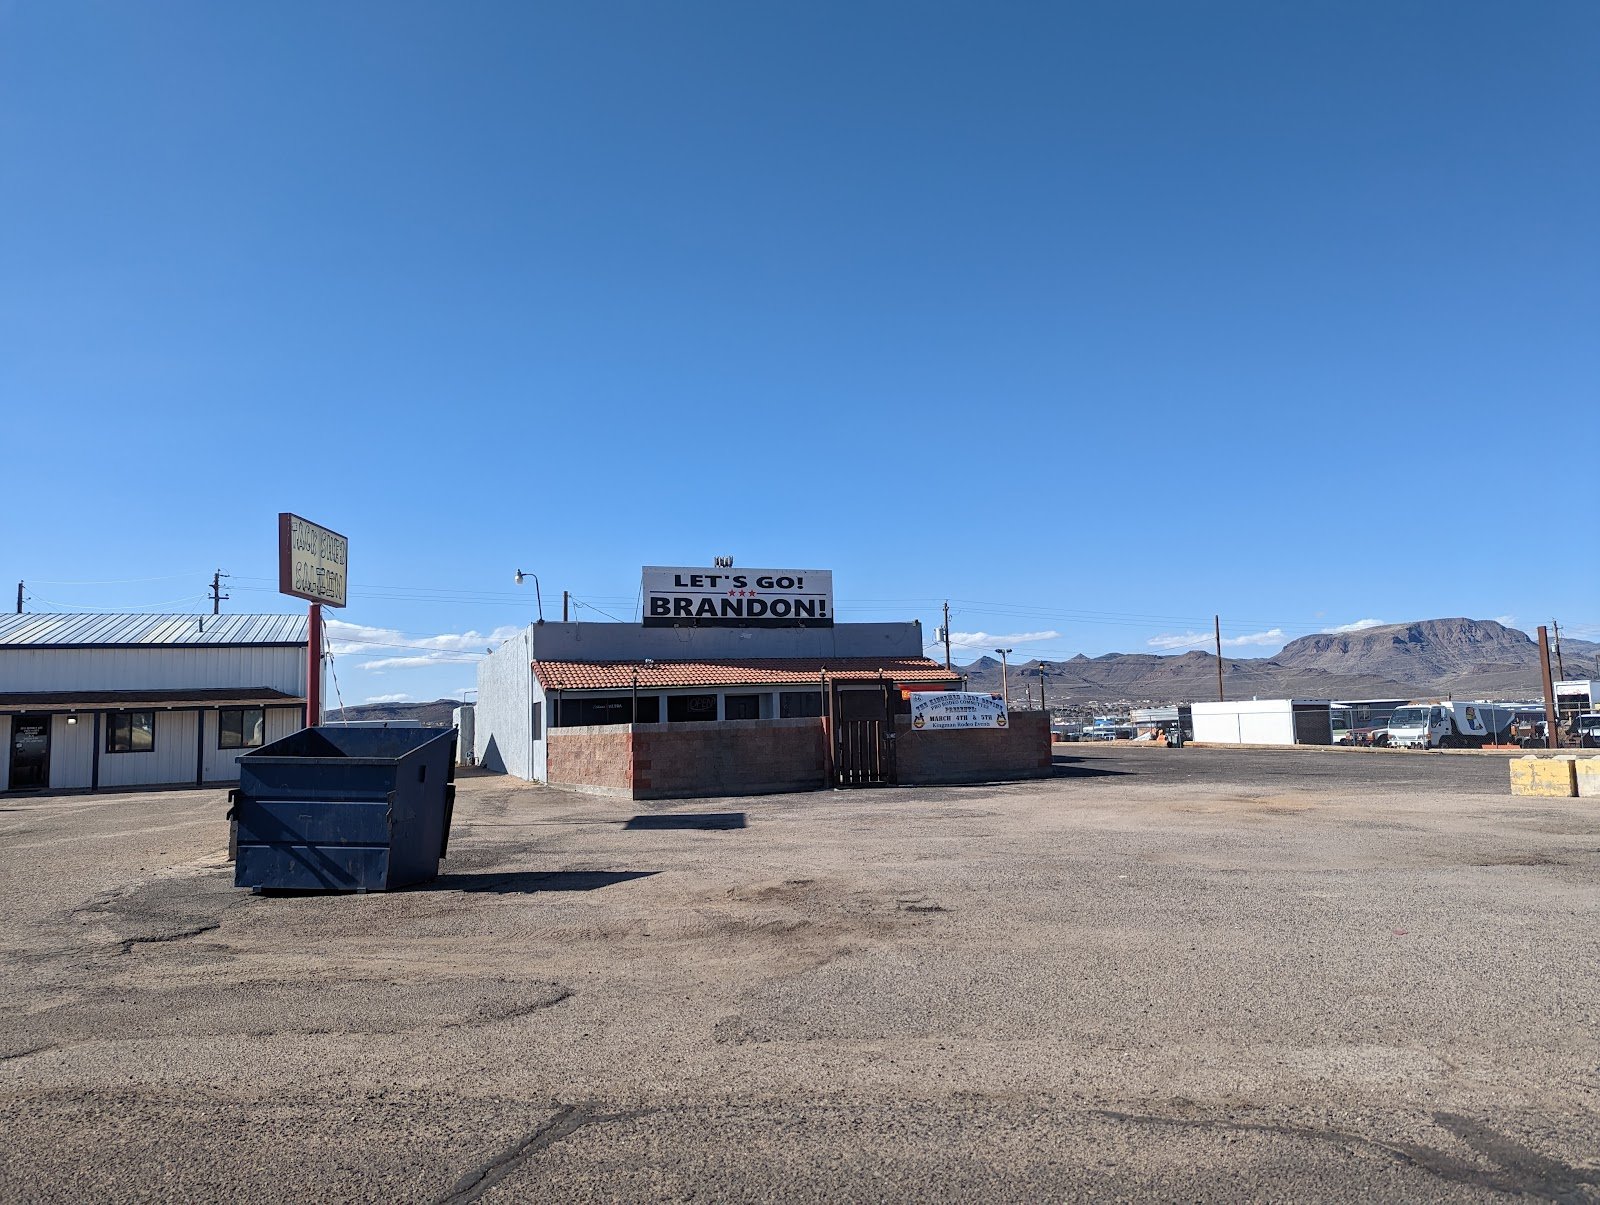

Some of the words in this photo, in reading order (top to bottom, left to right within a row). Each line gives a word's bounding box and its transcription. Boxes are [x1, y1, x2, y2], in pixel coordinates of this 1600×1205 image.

[674, 574, 748, 588] LET'S
[756, 576, 803, 590] GO!
[650, 596, 827, 617] BRANDON!
[932, 721, 956, 729] Kingman
